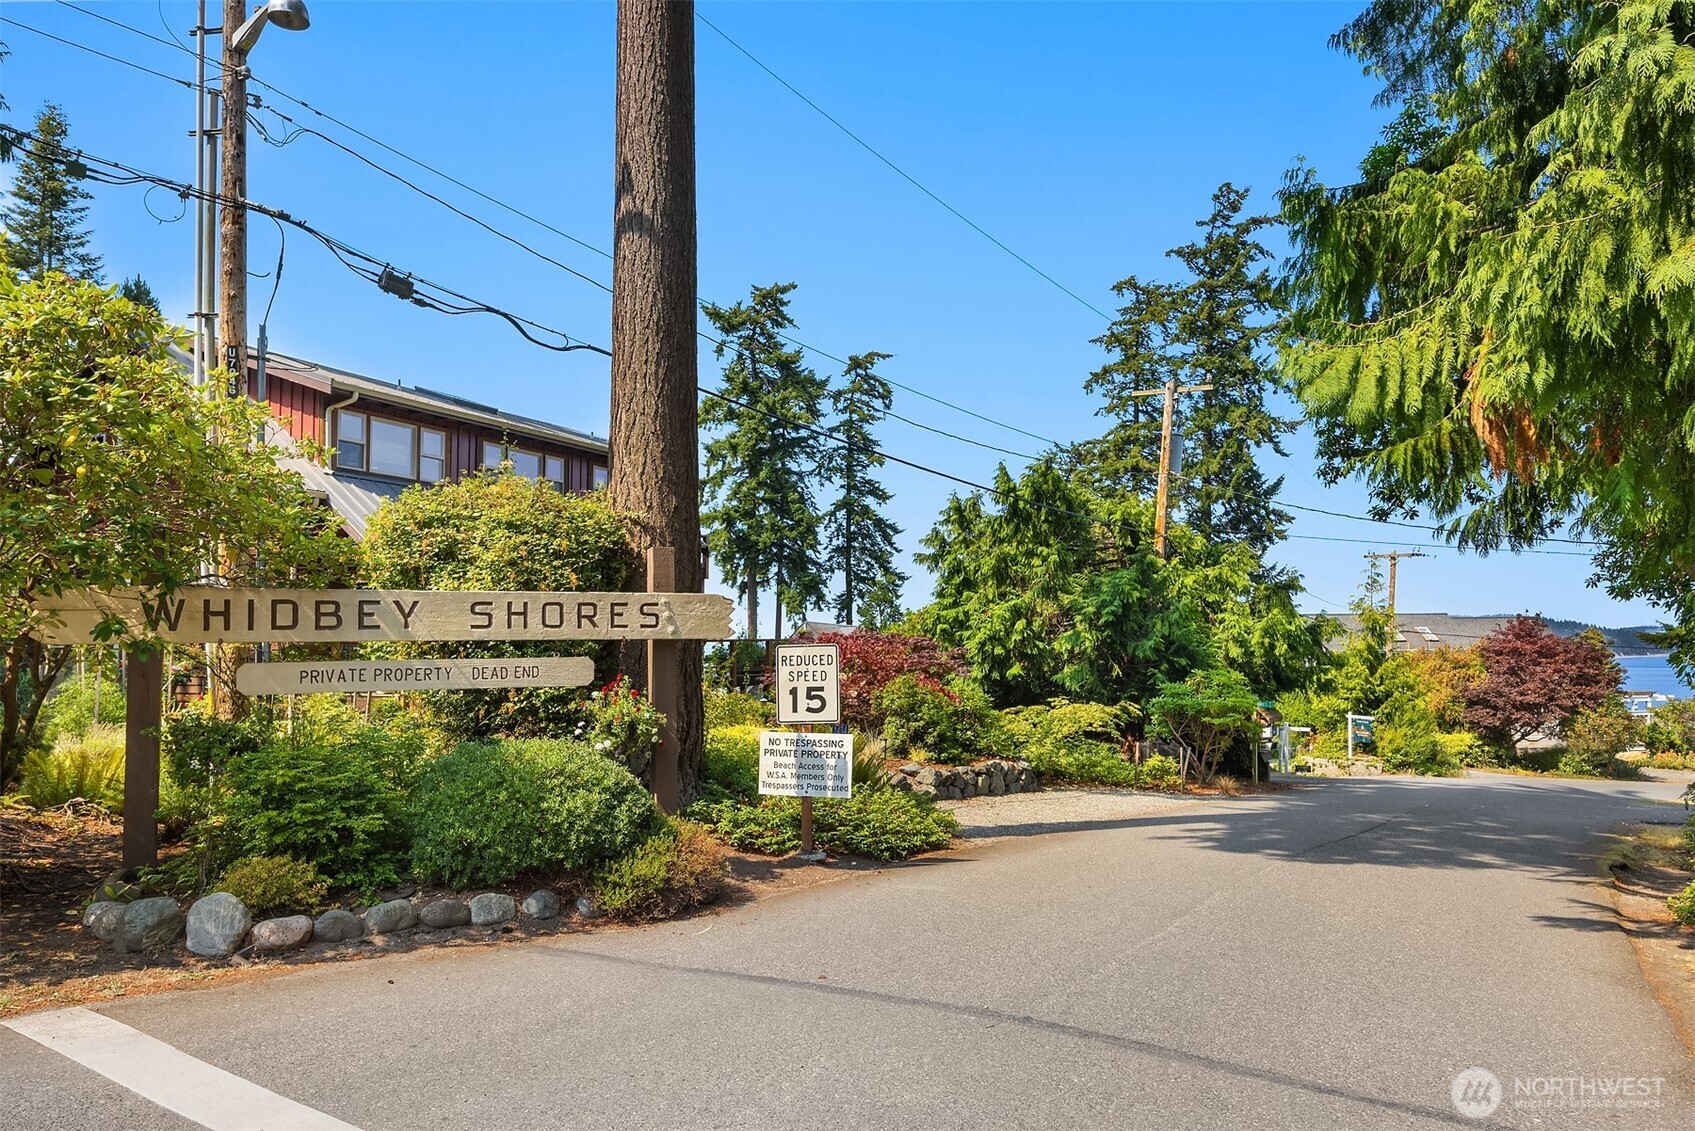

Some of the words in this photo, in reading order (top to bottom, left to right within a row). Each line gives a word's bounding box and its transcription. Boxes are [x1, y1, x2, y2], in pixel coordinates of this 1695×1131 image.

[142, 598, 420, 632] WHIDBEY
[469, 600, 660, 630] SHORES
[781, 654, 834, 667] REDUCED
[299, 668, 367, 685] PRIVATE
[373, 667, 453, 682] PROPERTY
[471, 666, 509, 680] DEAD
[514, 665, 540, 679] END
[788, 670, 828, 682] SPEED
[788, 686, 827, 714] 15
[768, 737, 782, 747] NO
[784, 738, 845, 749] TRESPASSING
[763, 748, 798, 759] PRIVATE
[800, 750, 849, 760] PROPERTY
[773, 761, 797, 770] Beach
[798, 762, 825, 771] Access
[826, 763, 838, 772] for
[766, 771, 788, 780] W.S.A.
[790, 772, 825, 781] Members
[827, 774, 845, 783] Only
[761, 781, 804, 792] Trespassers
[806, 783, 849, 793] Prosecuted
